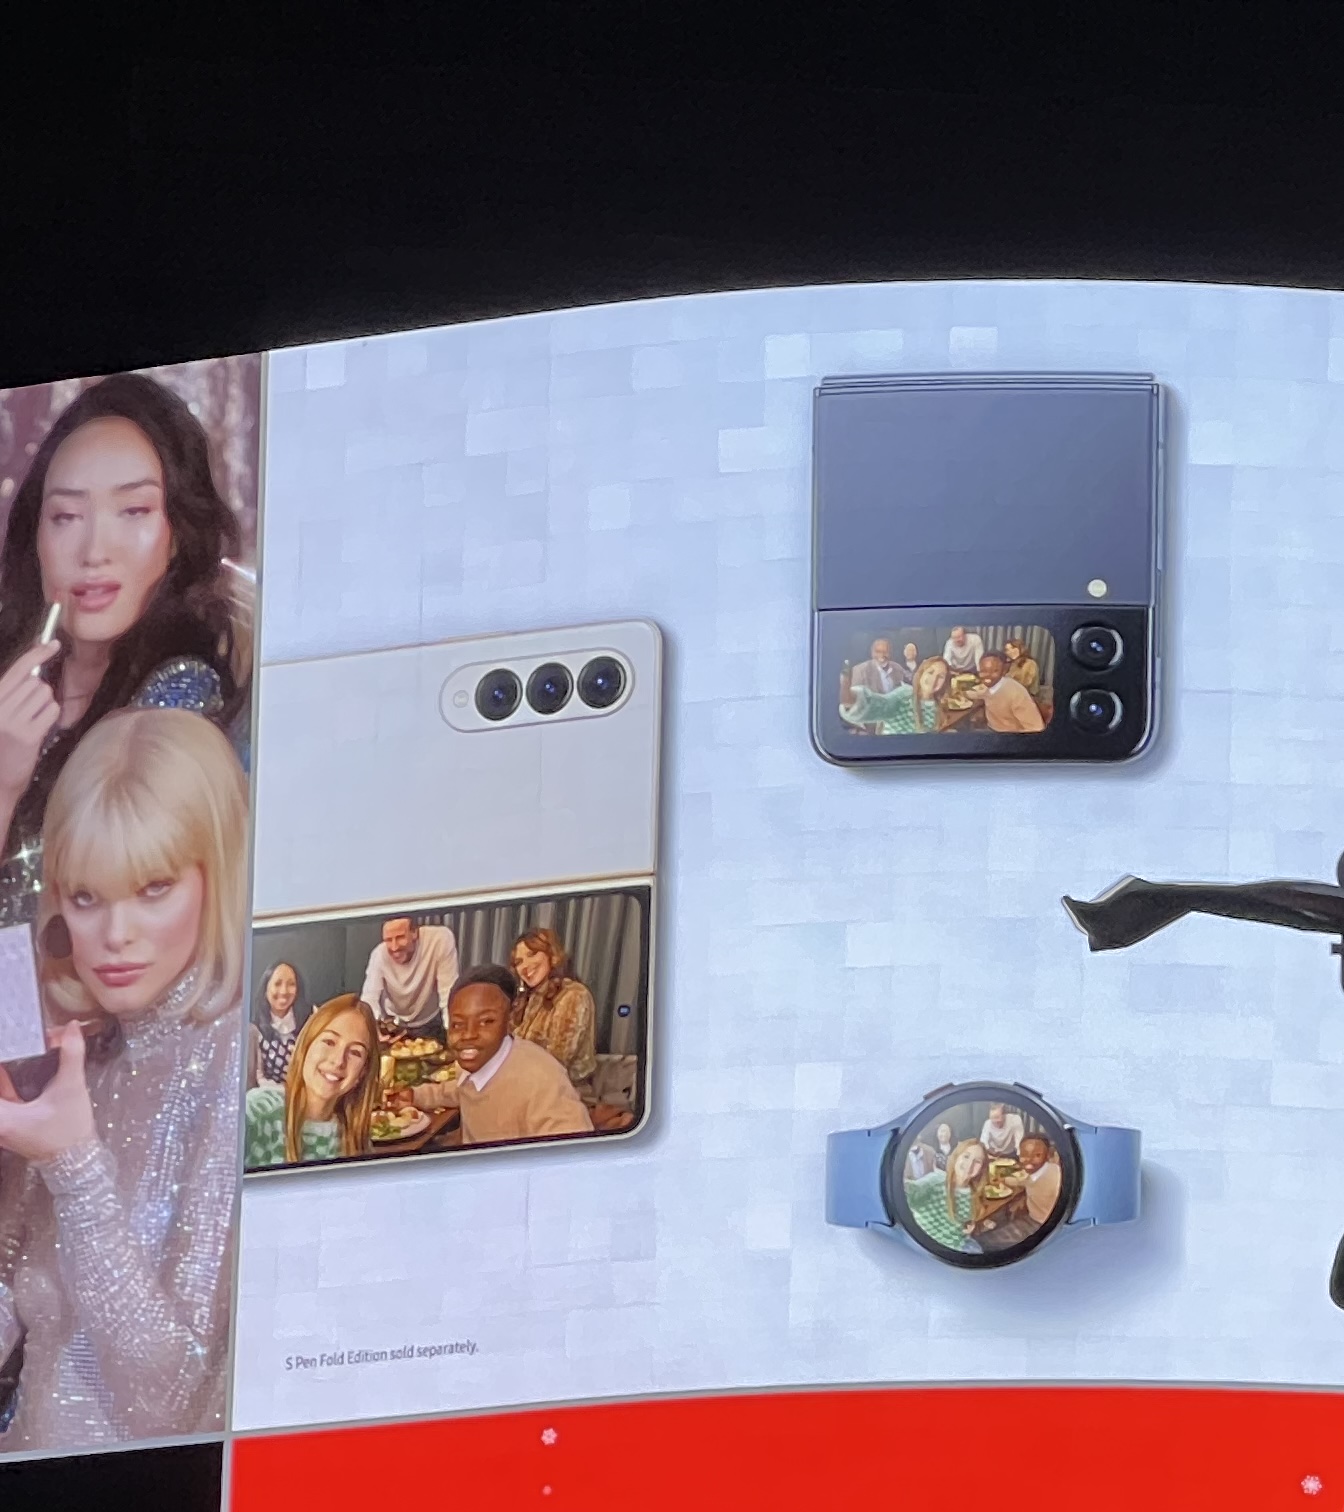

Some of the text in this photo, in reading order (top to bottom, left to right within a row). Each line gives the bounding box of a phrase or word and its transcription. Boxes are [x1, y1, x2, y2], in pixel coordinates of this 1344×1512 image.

[285, 1338, 479, 1371] S Pen Fold Edition sold separately.
